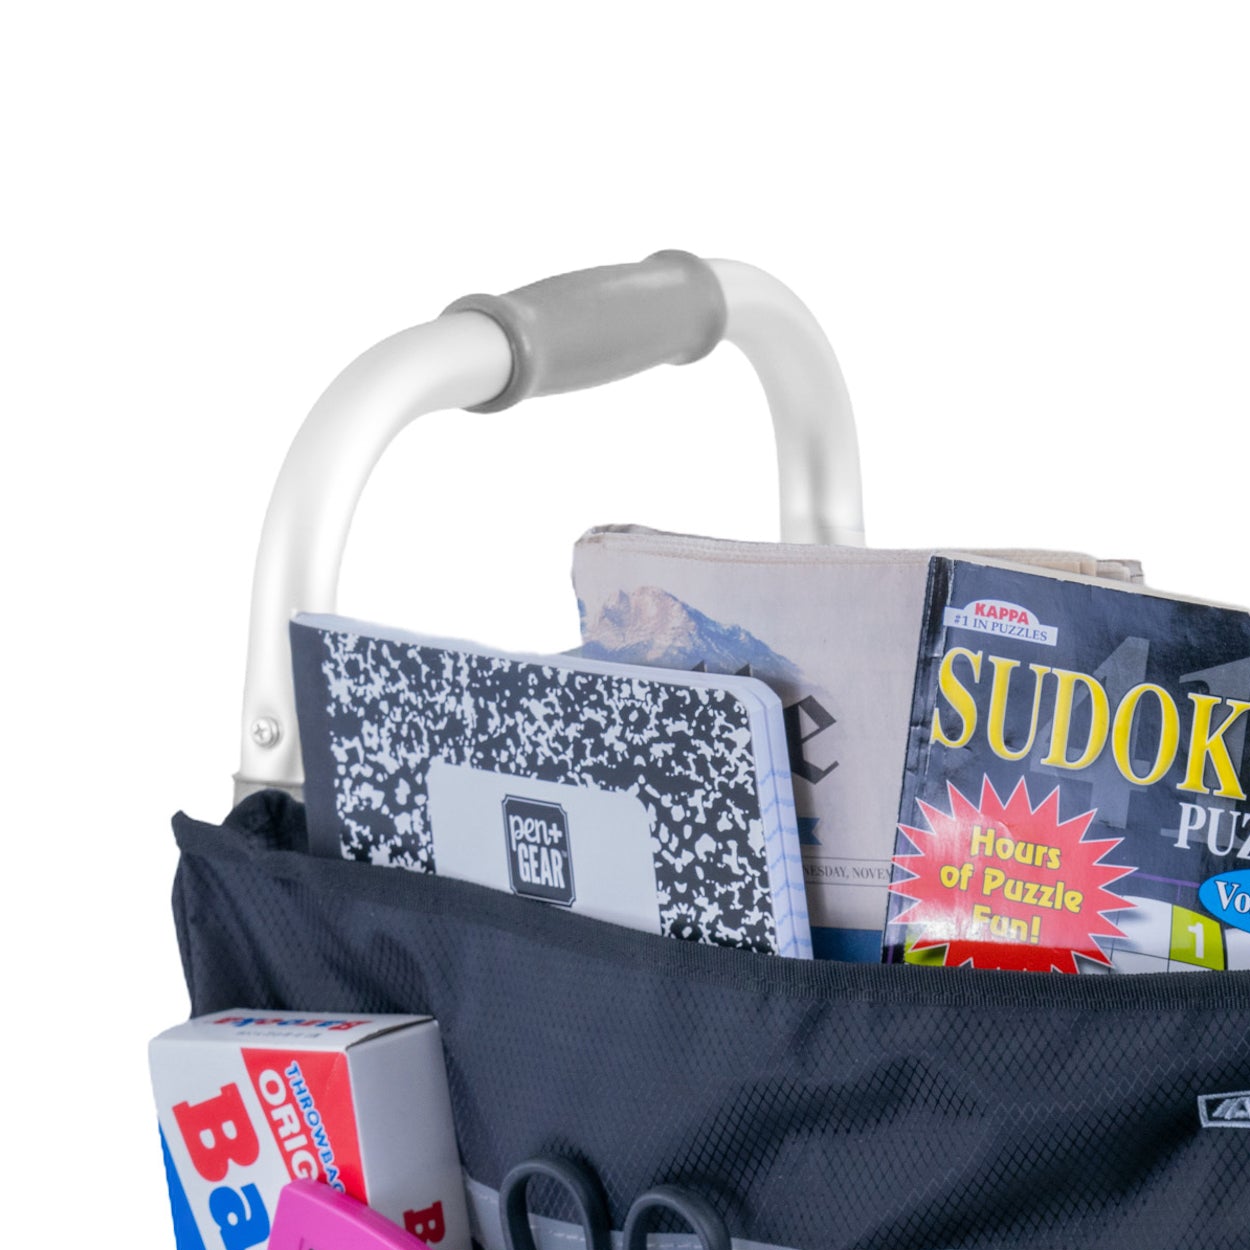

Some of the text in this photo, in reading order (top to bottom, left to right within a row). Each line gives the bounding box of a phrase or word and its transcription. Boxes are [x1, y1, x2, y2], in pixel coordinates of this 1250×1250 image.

[954, 614, 1049, 642] #1 IN PUZZLES
[975, 603, 1029, 625] KAPPA
[517, 842, 566, 889] GEAR
[970, 825, 1062, 870] Hours
[940, 863, 1084, 914] of Puzzle
[971, 903, 1042, 945] Fun!
[1187, 922, 1205, 959] 1
[258, 1069, 319, 1183] ORIG
